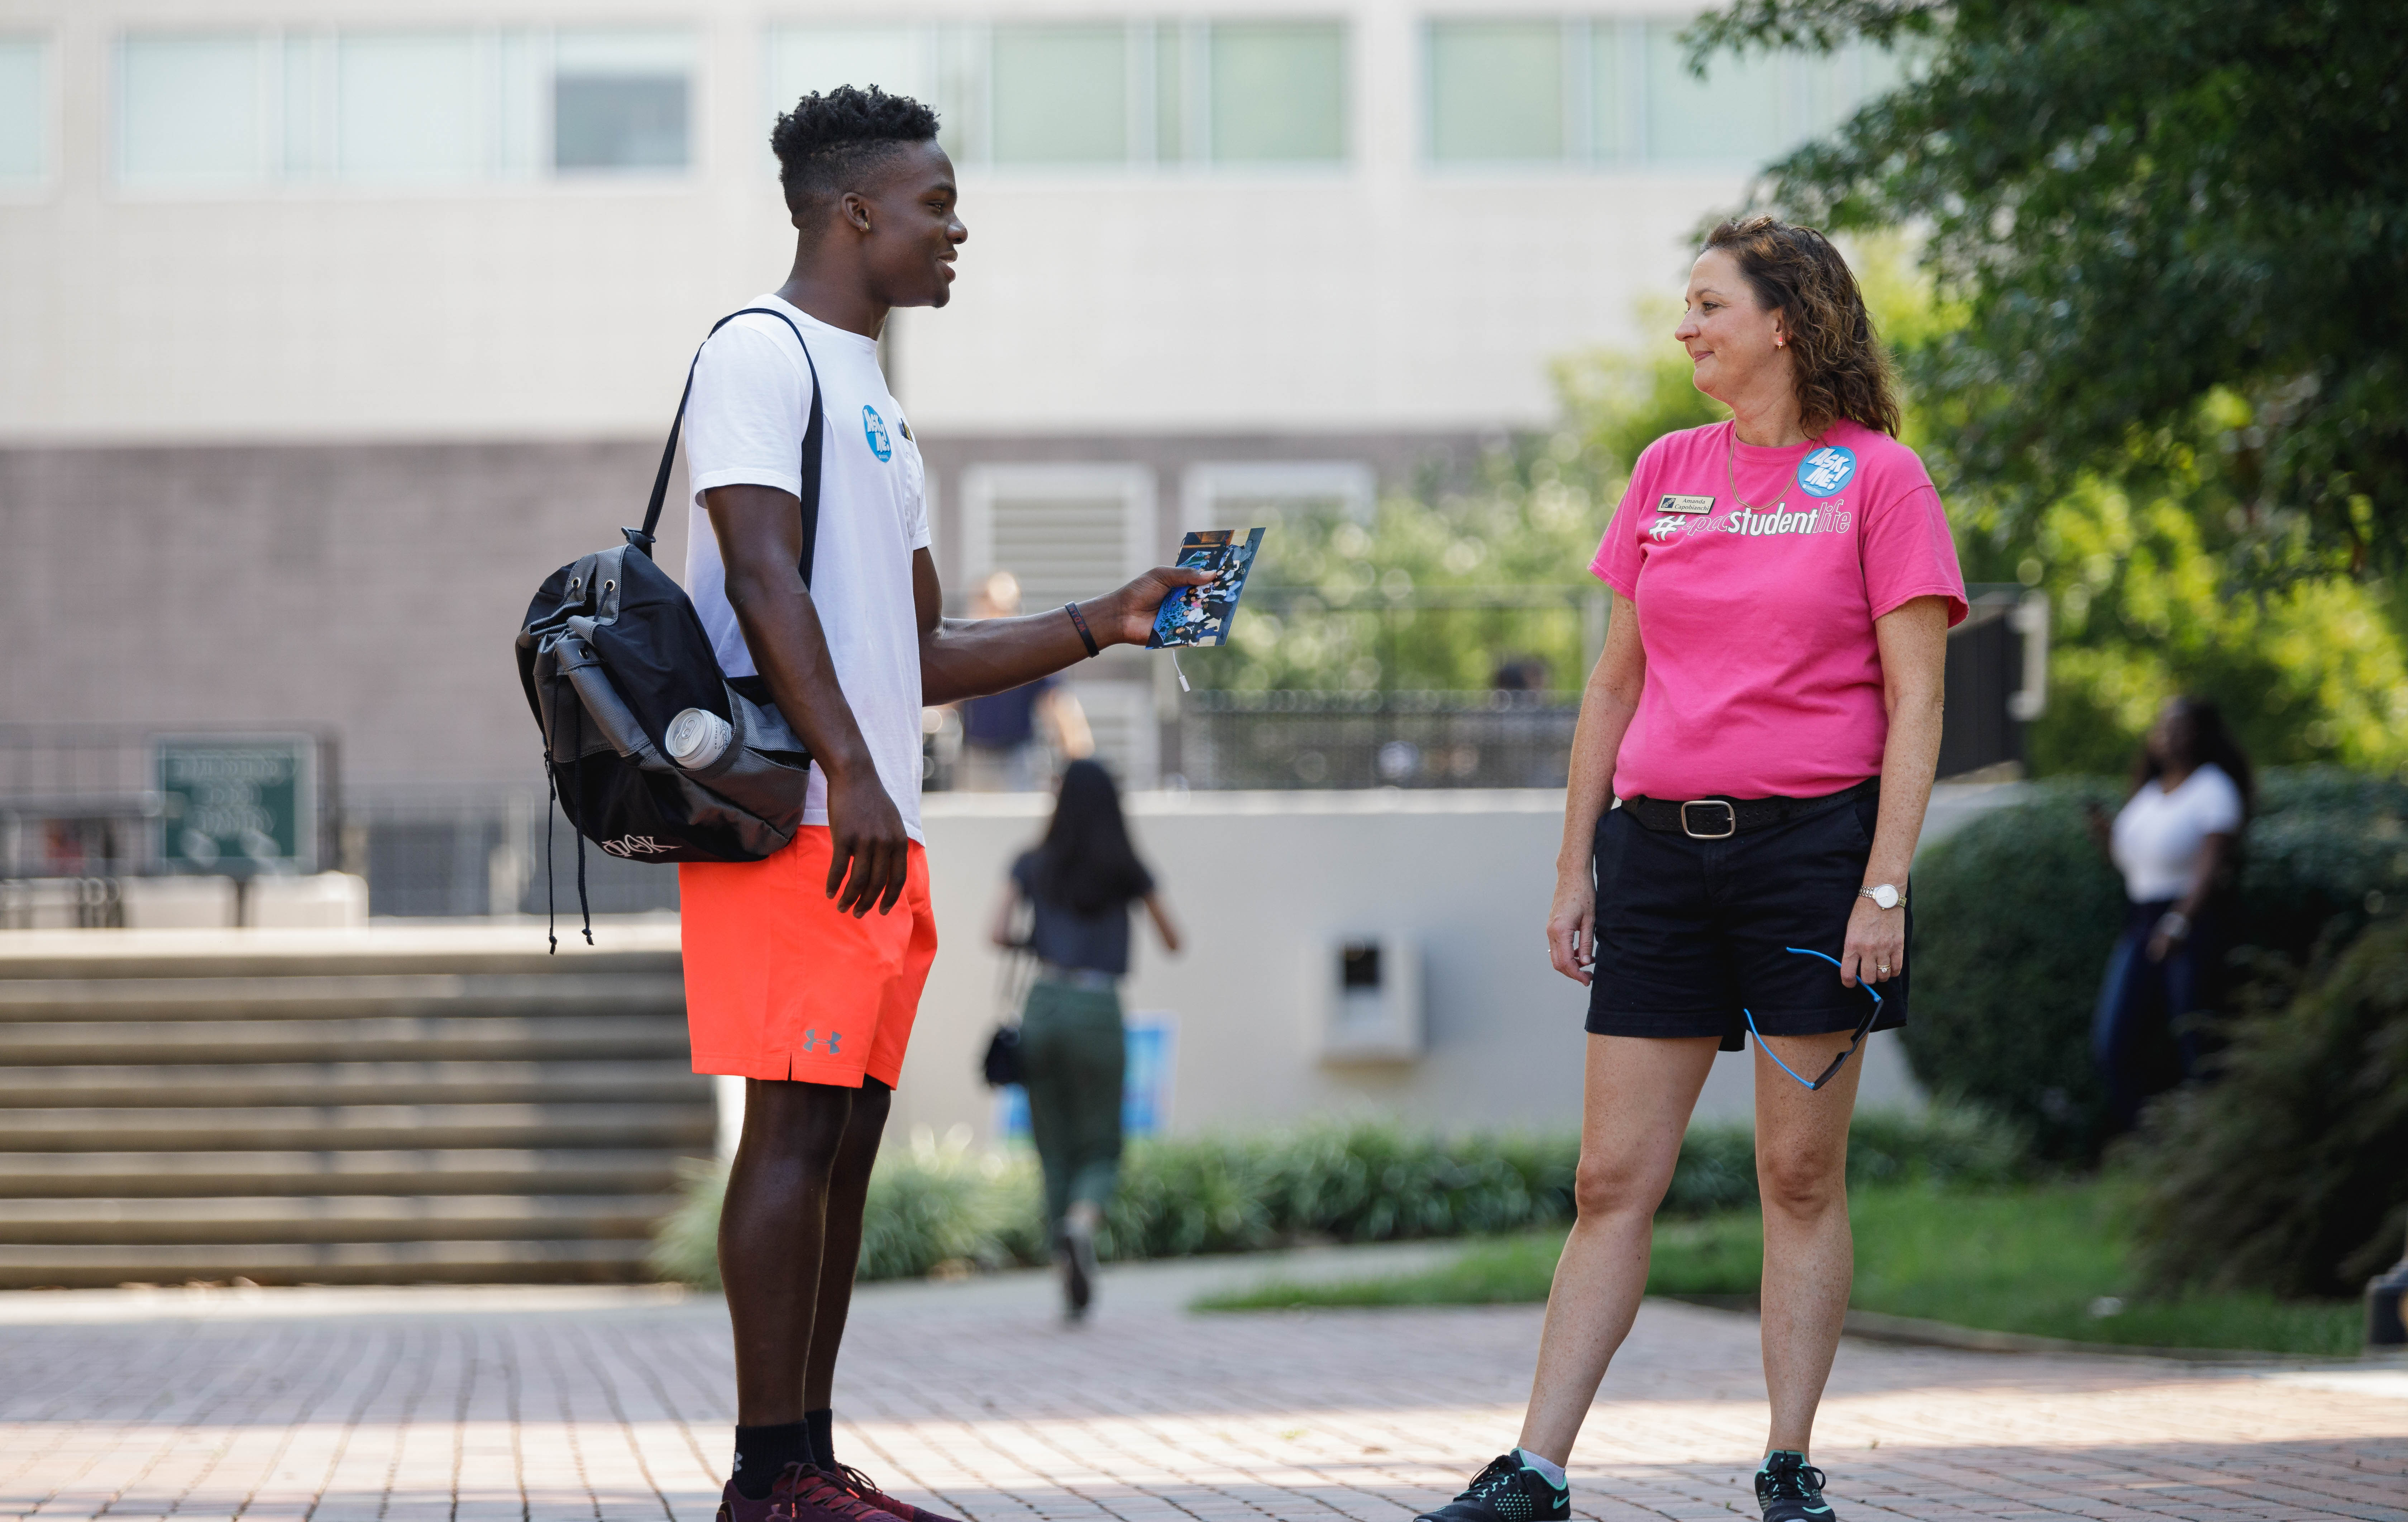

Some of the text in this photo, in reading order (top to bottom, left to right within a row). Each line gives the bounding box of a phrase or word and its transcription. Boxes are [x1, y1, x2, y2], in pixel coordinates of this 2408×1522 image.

[863, 409, 883, 433] ASK
[1807, 448, 1850, 472] ASK
[1805, 466, 1851, 490] ME!
